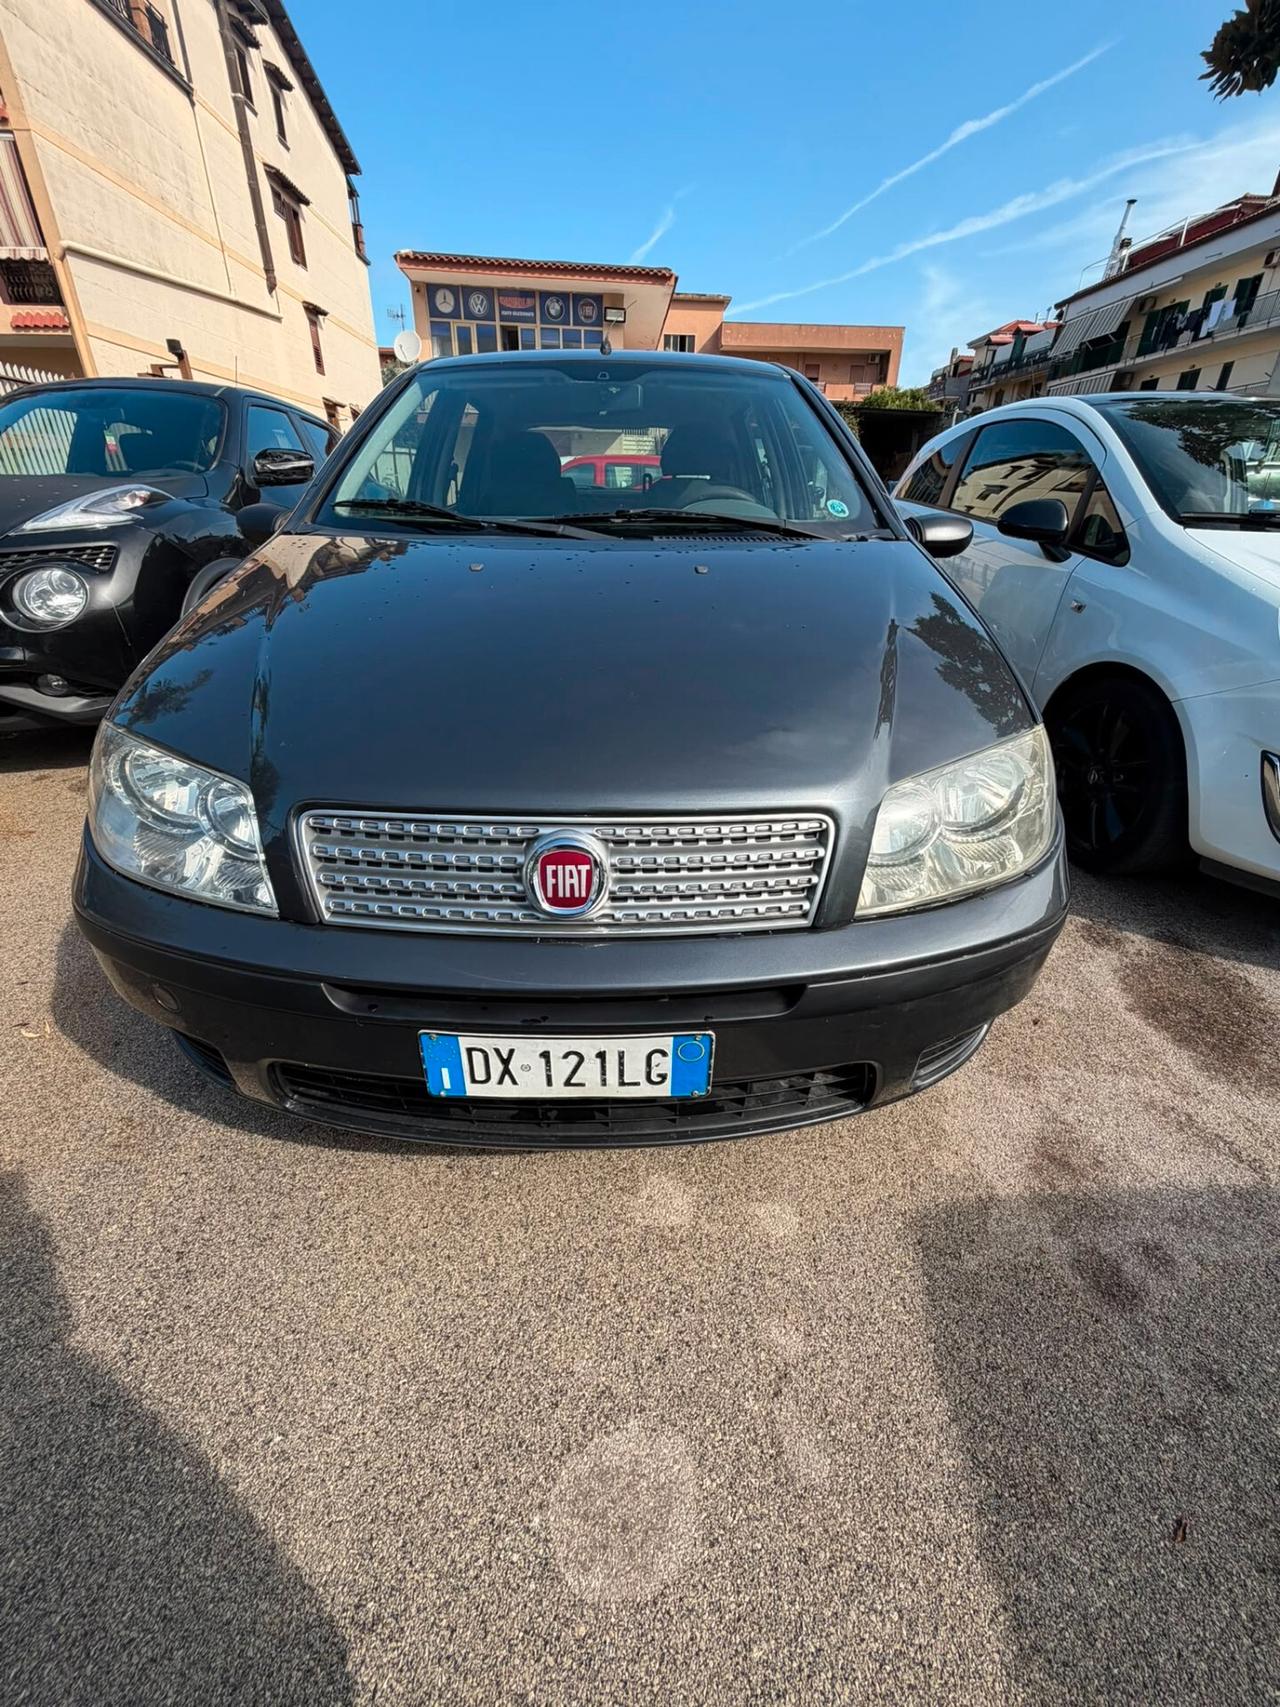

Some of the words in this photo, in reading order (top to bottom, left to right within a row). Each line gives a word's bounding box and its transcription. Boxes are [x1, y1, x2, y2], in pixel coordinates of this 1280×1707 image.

[546, 864, 591, 898] FIAT
[465, 1046, 519, 1086] DX
[538, 1048, 669, 1088] 121LG
